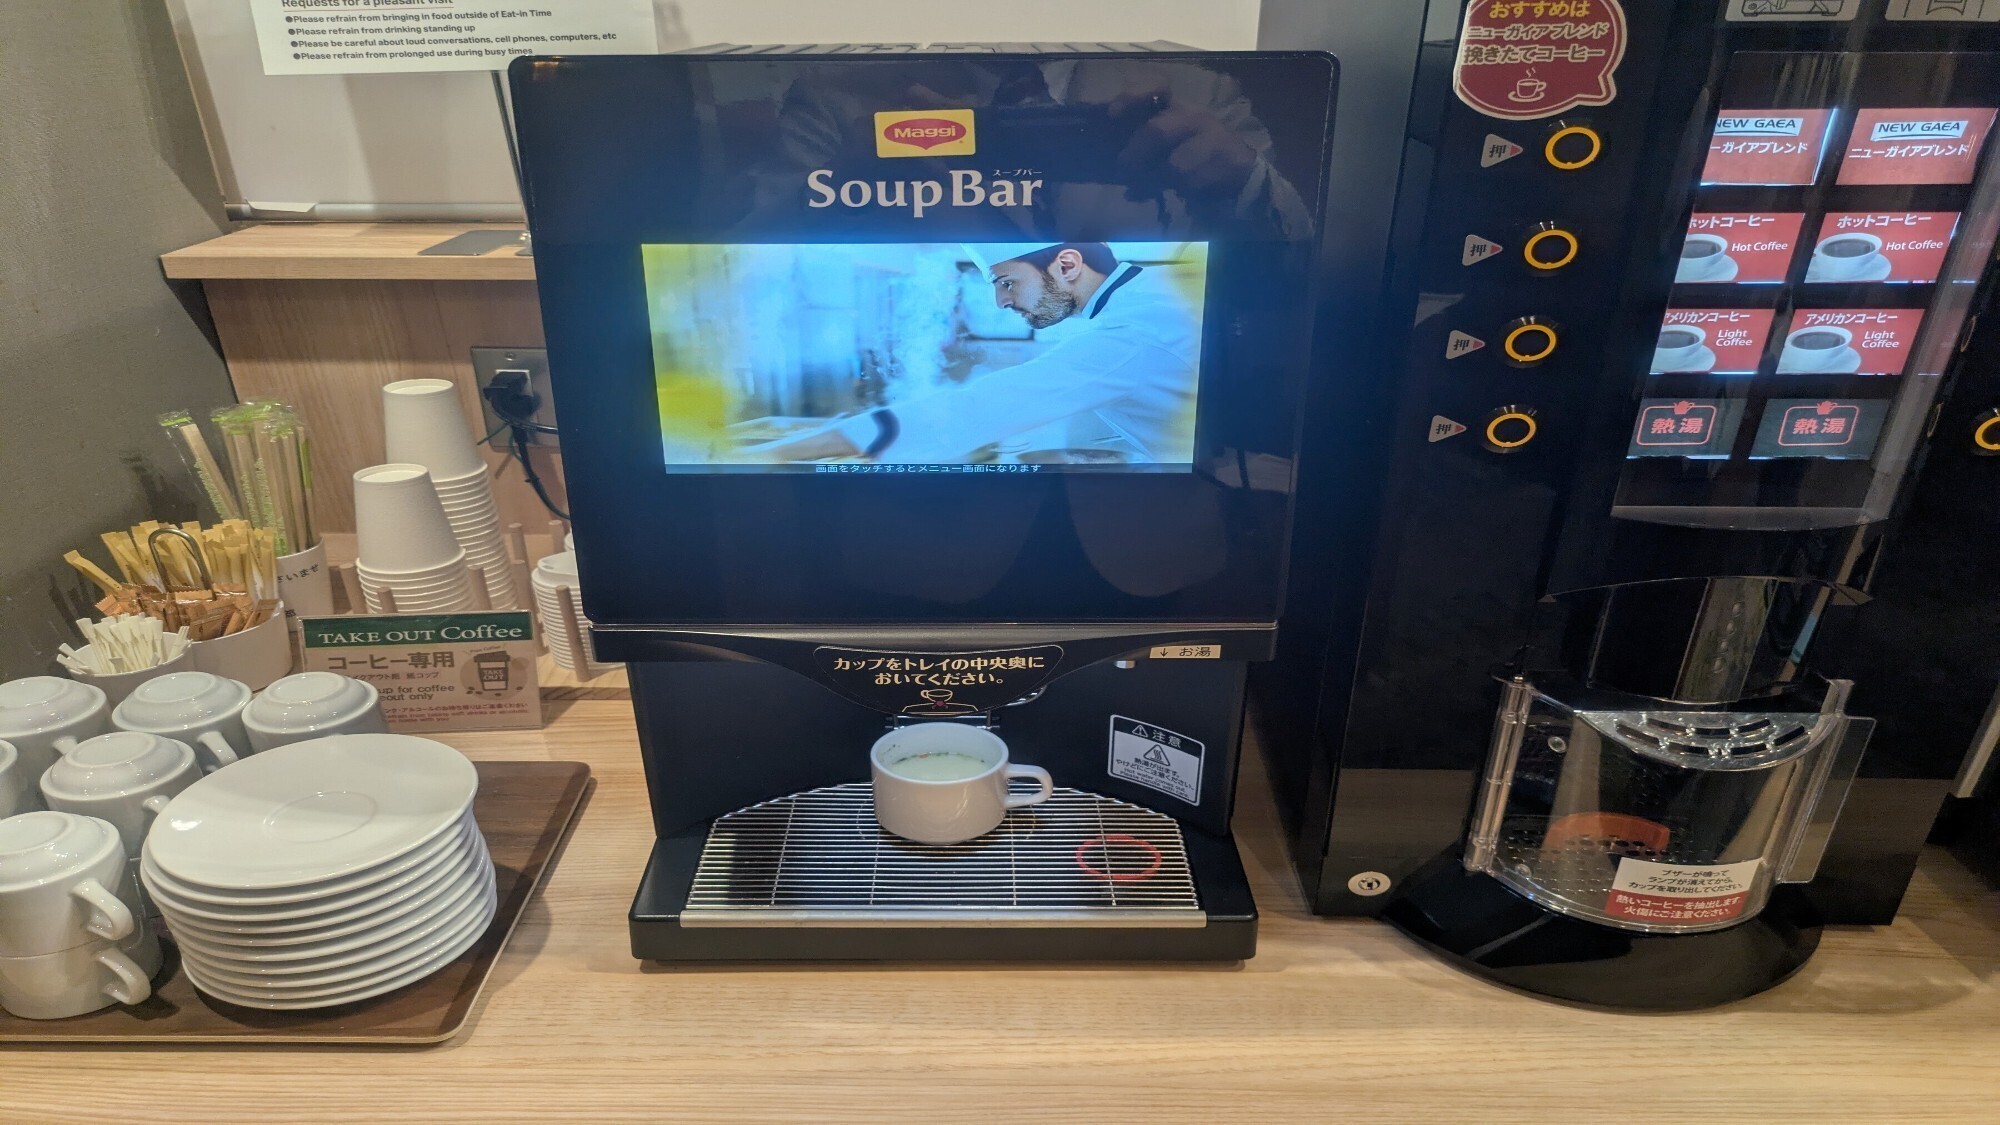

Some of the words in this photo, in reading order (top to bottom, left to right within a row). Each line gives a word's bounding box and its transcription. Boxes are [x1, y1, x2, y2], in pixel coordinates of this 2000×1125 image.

[293, 15, 324, 23] Please
[358, 14, 380, 22] from
[382, 13, 420, 23] bringing
[431, 12, 453, 20] food
[454, 11, 488, 19] outside
[528, 9, 552, 17] Time
[1488, 1, 1590, 18] おすすめは
[328, 27, 360, 35] refrain
[385, 25, 422, 35] drinking
[423, 25, 462, 33] standing
[464, 25, 476, 33] up
[1467, 22, 1610, 40] ニューガイアブレンド
[298, 40, 329, 48] Please
[344, 39, 377, 47] careful
[378, 38, 404, 46] about
[495, 35, 511, 43] cell
[602, 32, 617, 40] etc
[301, 52, 331, 60] Please
[365, 51, 388, 59] from
[389, 50, 435, 60] prolonged
[454, 49, 483, 58] during
[484, 48, 506, 57] busy
[507, 47, 533, 55] times
[1463, 44, 1606, 63] 挽きたてコーヒー
[1754, 119, 1796, 128] GAEA
[1878, 123, 1917, 133] NEW
[1920, 122, 1960, 132] GAEA
[894, 125, 956, 139] Maggi
[1488, 144, 1507, 158] 押
[1848, 143, 1970, 159] ニューガイアブレンド
[992, 168, 1042, 177] スープバー
[807, 169, 943, 218] Soup
[949, 169, 1043, 207] Bar
[1837, 213, 1932, 229] ホットコーヒー
[1731, 242, 1751, 252] Hot
[1753, 241, 1788, 251] Coffee
[1886, 240, 1909, 251] Hot
[1912, 239, 1944, 250] Coffee
[1804, 312, 1898, 325] アメリカンコーヒー
[1717, 329, 1748, 340] Light
[1863, 330, 1896, 342] Light
[1453, 338, 1470, 351] 押
[1715, 338, 1753, 347] Coffee
[1861, 339, 1900, 349] Coffee
[1650, 417, 1704, 434] 熱湯
[1792, 417, 1846, 434] 熱湯
[815, 464, 1042, 473] 画面をタッチするとメニュー画面になります
[318, 631, 382, 644] TAKE
[385, 629, 436, 642] OUT
[440, 624, 523, 640] Coffee
[1179, 646, 1211, 657] お湯
[328, 651, 455, 670] コーヒー専用
[833, 656, 1045, 671] カップをトレイの中央奥に
[874, 672, 1004, 685] おいてください。
[417, 685, 455, 693] coffee
[409, 692, 434, 701] only
[1152, 729, 1182, 748] 注意
